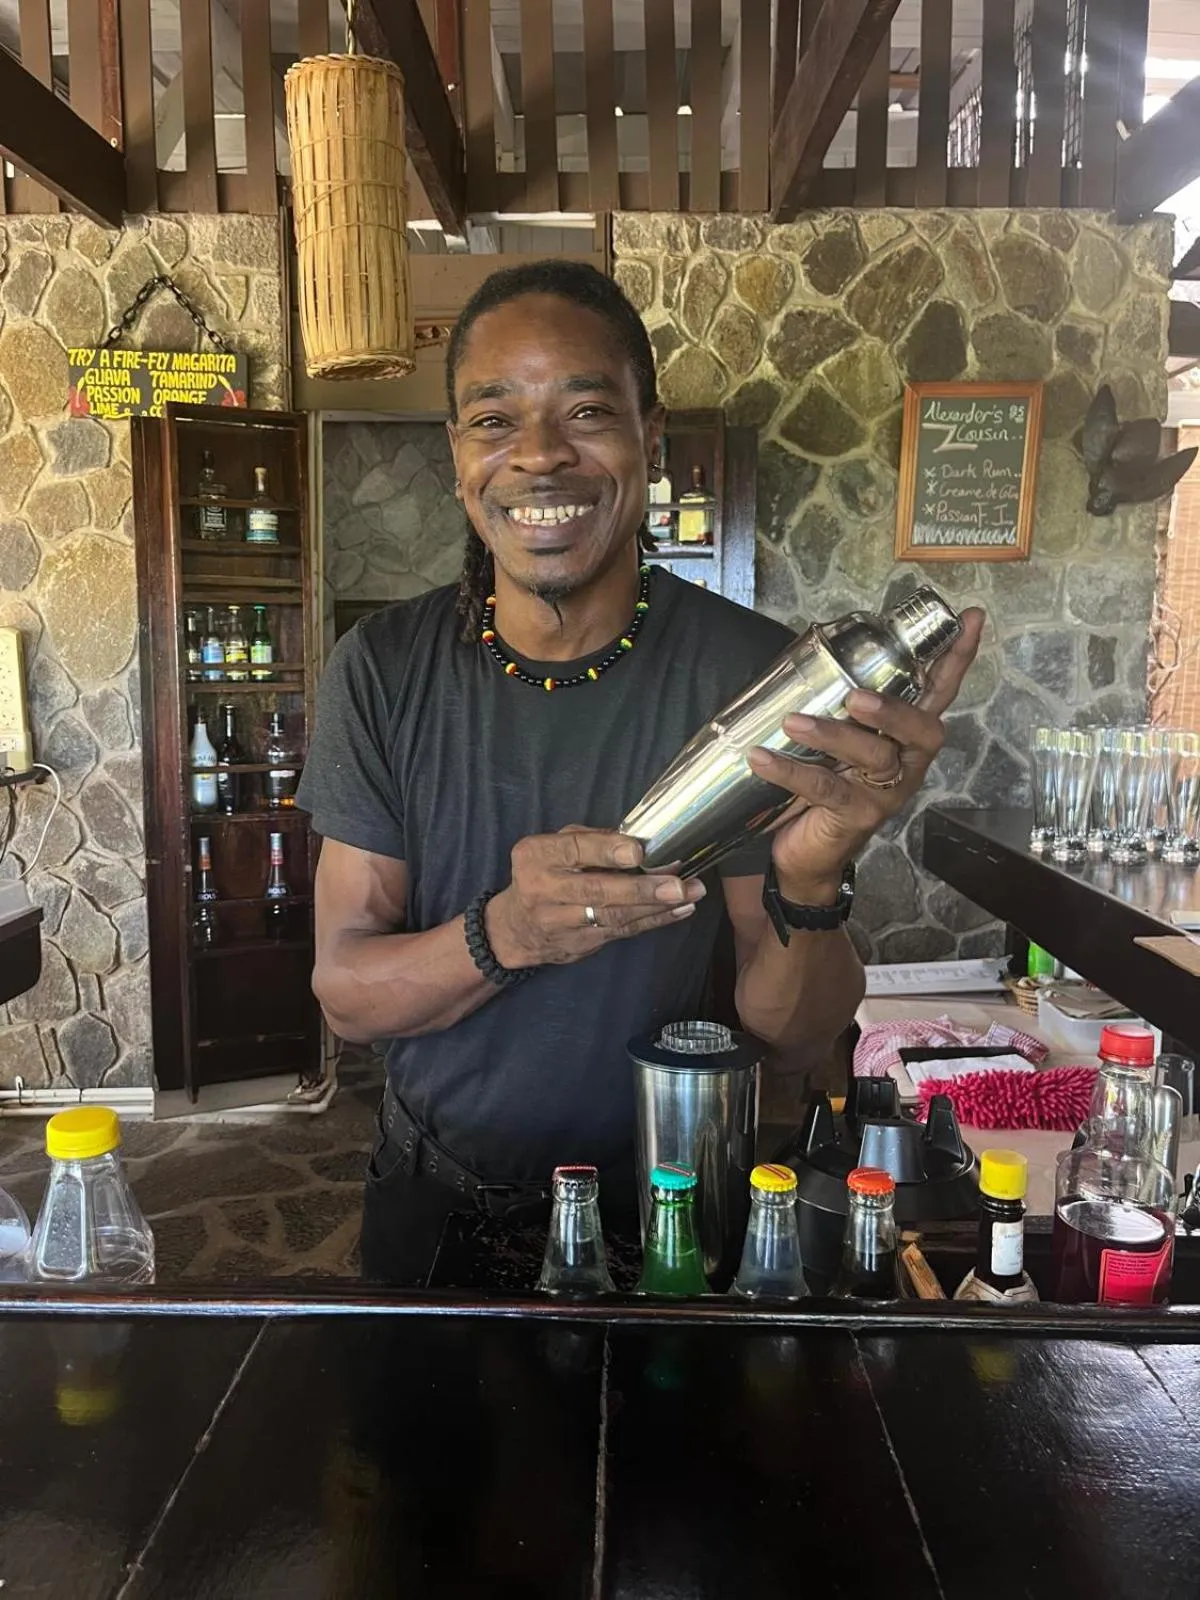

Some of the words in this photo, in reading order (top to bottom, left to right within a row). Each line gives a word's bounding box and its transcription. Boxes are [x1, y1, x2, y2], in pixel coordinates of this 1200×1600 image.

[68, 348, 96, 366] TRY
[99, 349, 110, 368] A
[171, 352, 236, 373] MAGARITA
[85, 367, 131, 386] GUAVA
[149, 370, 218, 389] TAMARIND
[86, 385, 141, 404] PASSION
[89, 402, 120, 415] LIME
[941, 464, 977, 479] Dark
